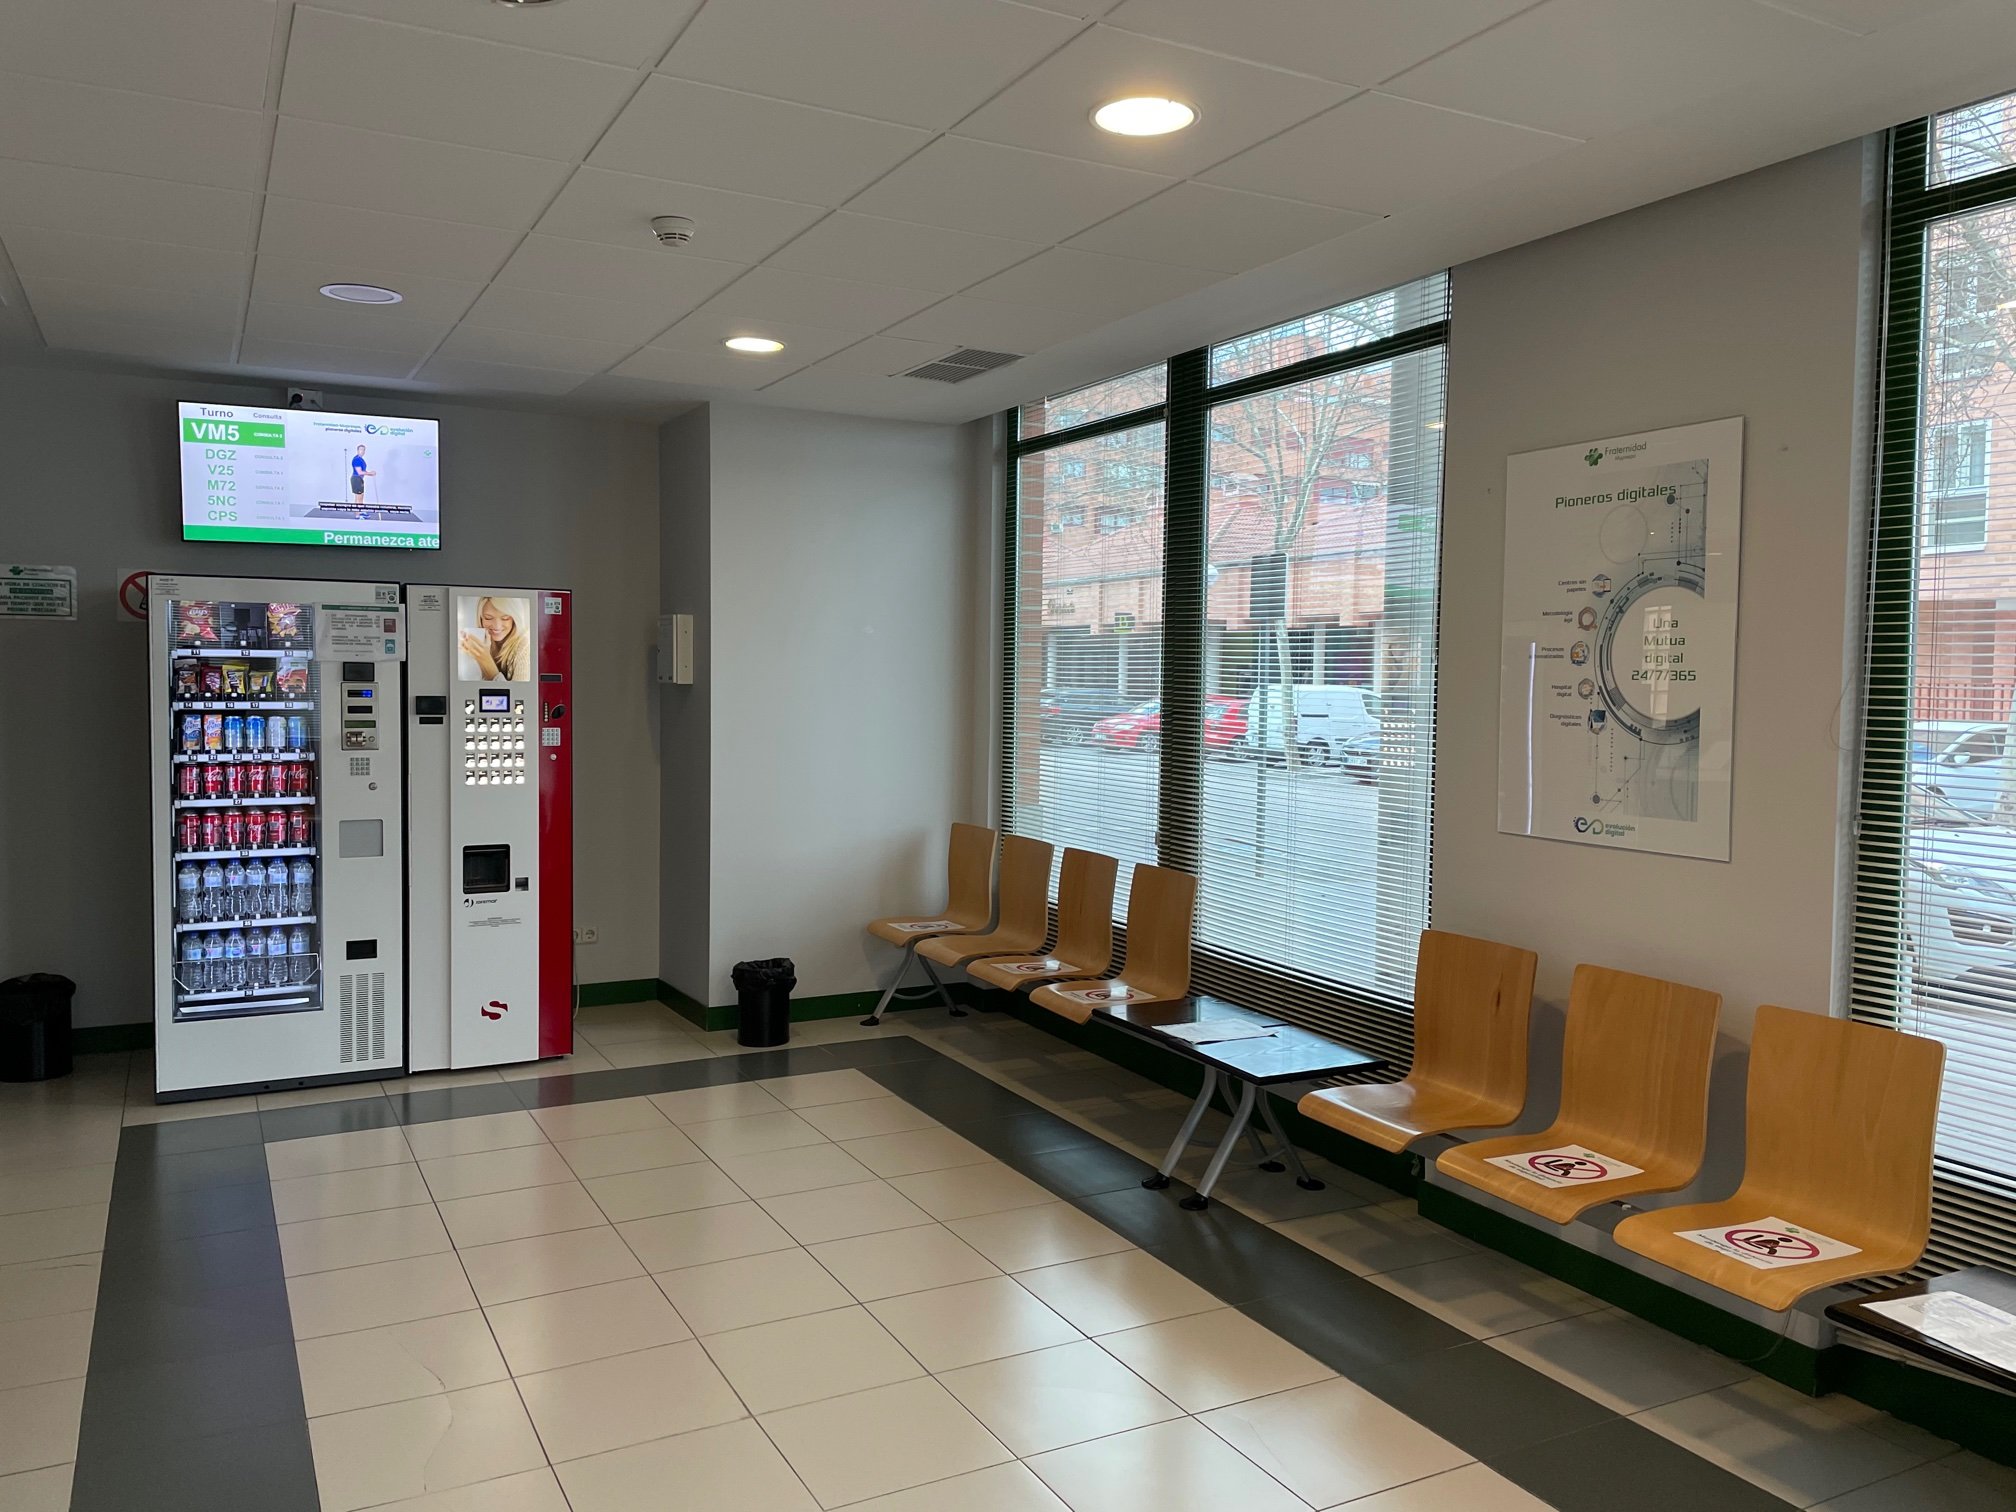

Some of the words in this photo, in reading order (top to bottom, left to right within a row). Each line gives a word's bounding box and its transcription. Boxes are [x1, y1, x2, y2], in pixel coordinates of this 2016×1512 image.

[201, 408, 234, 418] Turno
[253, 412, 282, 420] Consulta
[191, 422, 240, 441] VM5
[1604, 441, 1647, 455] Fraternidad
[205, 448, 237, 460] DGZ
[207, 464, 234, 476] V25
[207, 480, 236, 491] M72
[208, 495, 237, 506] 5NC
[1555, 493, 1613, 508] Pioneros
[1617, 485, 1677, 503] digitales
[208, 511, 238, 522] CPS
[324, 532, 414, 546] Permanezca
[418, 536, 440, 547] ate
[1653, 618, 1679, 629] Una
[1643, 635, 1686, 646] Mutua
[1645, 652, 1684, 666] digital
[1631, 670, 1697, 681] 24/7/365
[1605, 823, 1635, 831] evolución
[1605, 829, 1624, 837] digital
